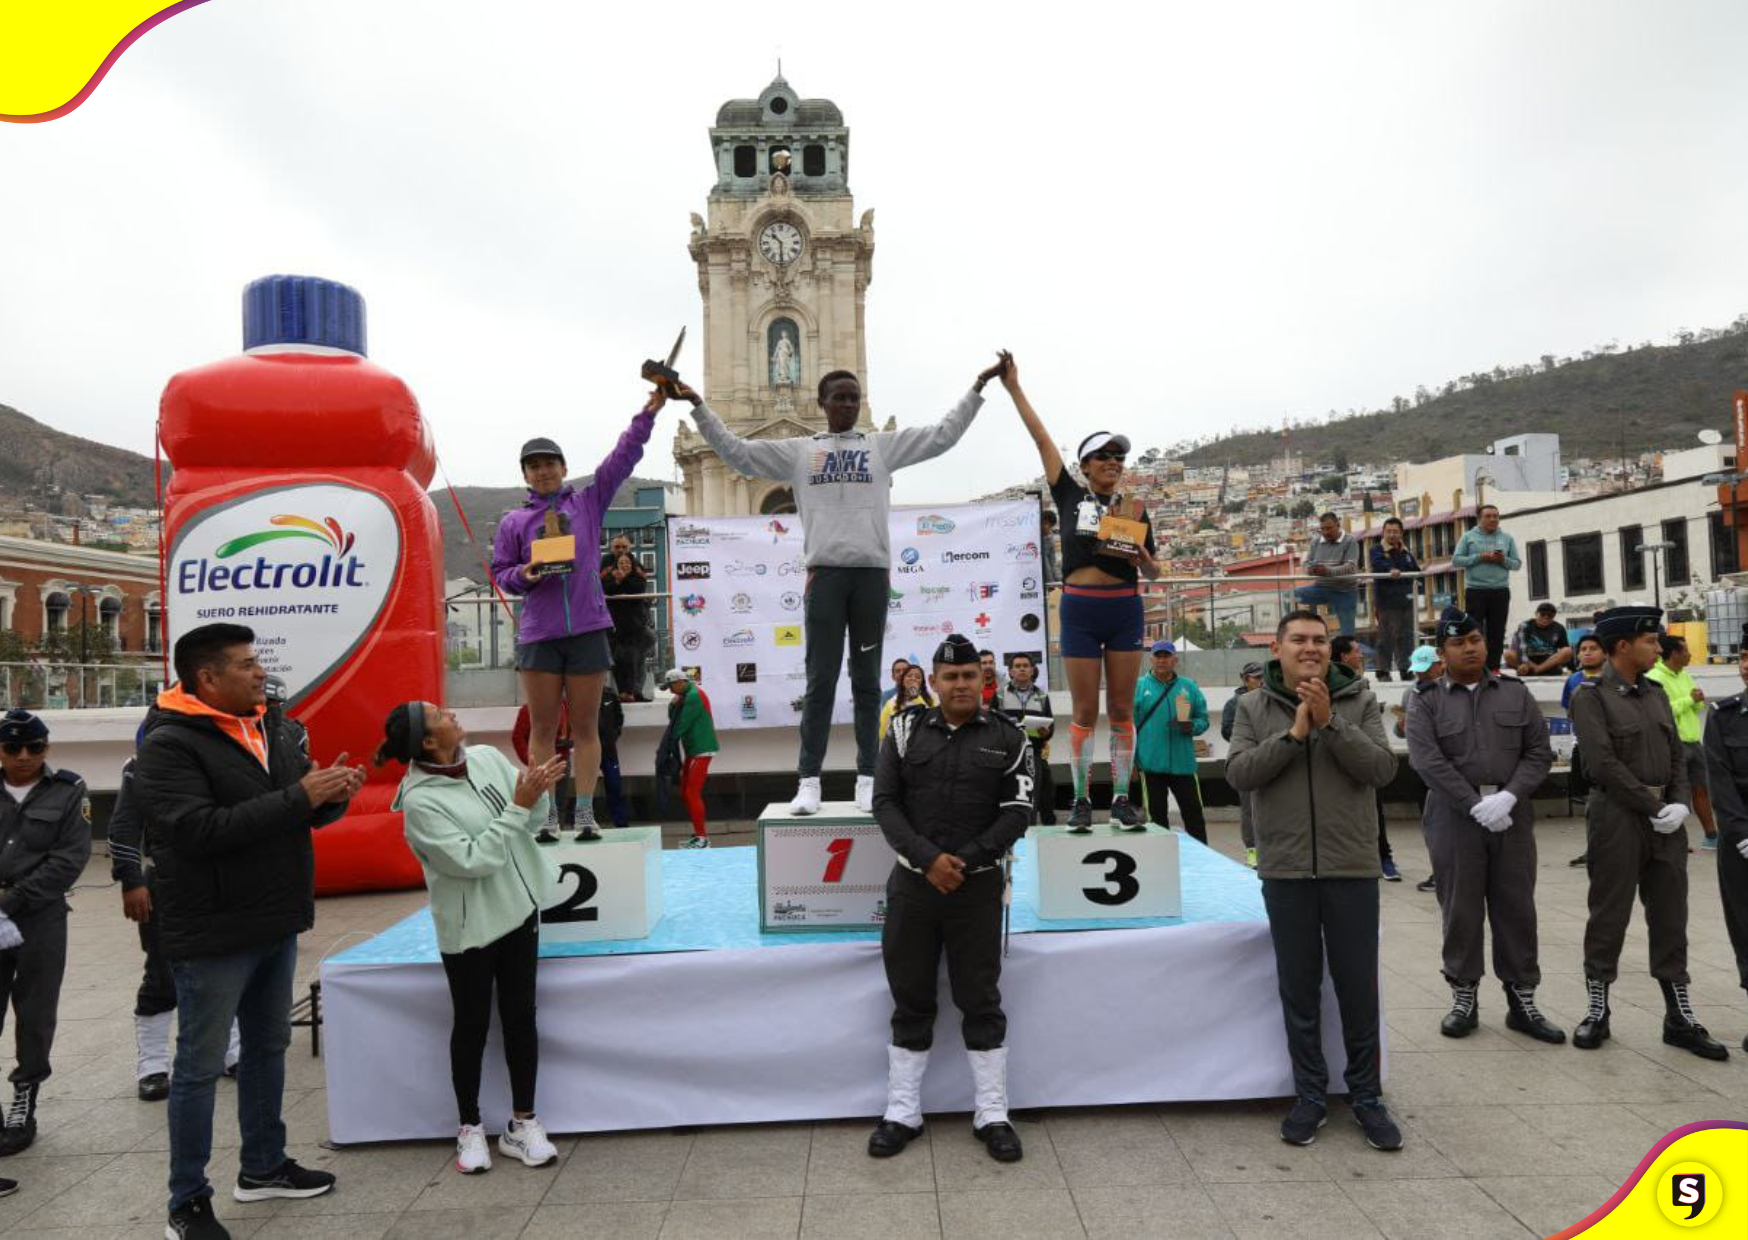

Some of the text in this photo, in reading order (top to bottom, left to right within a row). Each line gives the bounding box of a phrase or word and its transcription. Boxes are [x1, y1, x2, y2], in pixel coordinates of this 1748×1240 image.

[178, 554, 365, 594] Electrolit
[677, 563, 711, 577] Jeep
[898, 565, 924, 574] MEGA
[197, 604, 339, 618] SUERO REHIDRATANTE
[1015, 774, 1034, 802] P
[822, 838, 854, 883] 1
[1081, 849, 1140, 906] 3
[539, 863, 599, 924] 2
